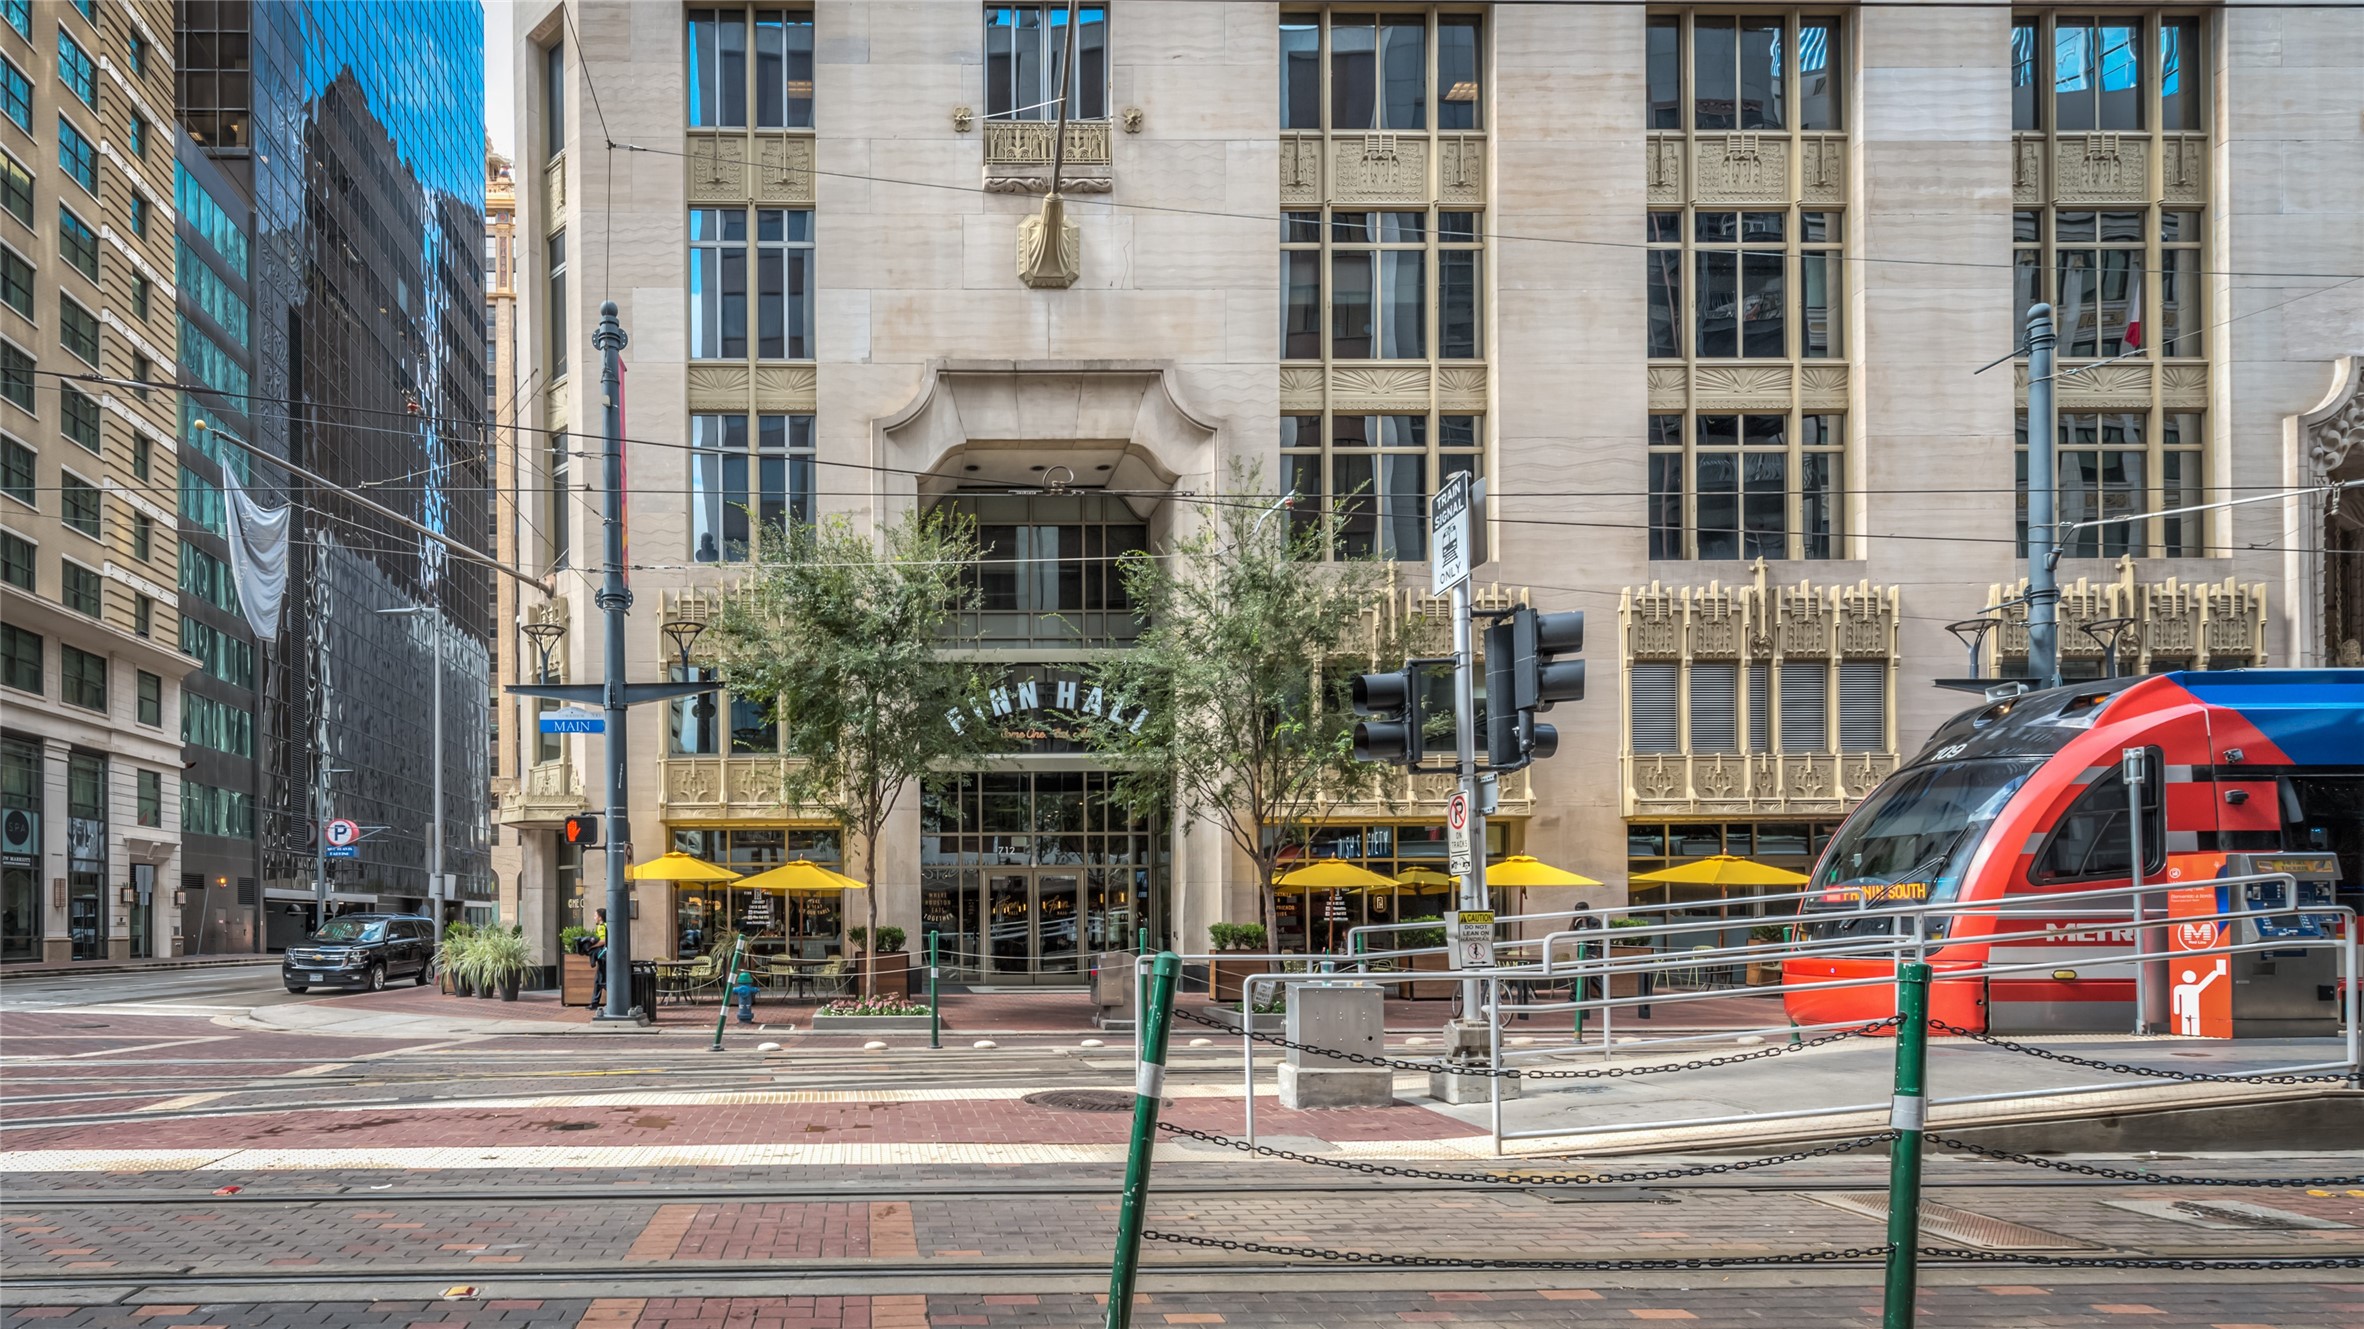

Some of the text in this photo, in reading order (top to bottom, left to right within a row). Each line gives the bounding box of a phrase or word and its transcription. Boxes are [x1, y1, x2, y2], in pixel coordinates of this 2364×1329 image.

[1436, 480, 1461, 510] TRAIN
[1434, 498, 1464, 530] SIGNAL
[1439, 561, 1461, 585] ONLY
[554, 721, 590, 731] MAIN
[1931, 743, 1968, 761] 109
[8, 822, 25, 832] SPA
[334, 824, 347, 841] P
[1356, 831, 1389, 856] SCIETY
[1451, 840, 1468, 848] TRACKS
[1455, 832, 1462, 840] ON
[998, 846, 1016, 856] 712
[1888, 882, 1926, 900] SOUTH
[1467, 914, 1493, 922] CAUTION
[2046, 923, 2135, 942] METR
